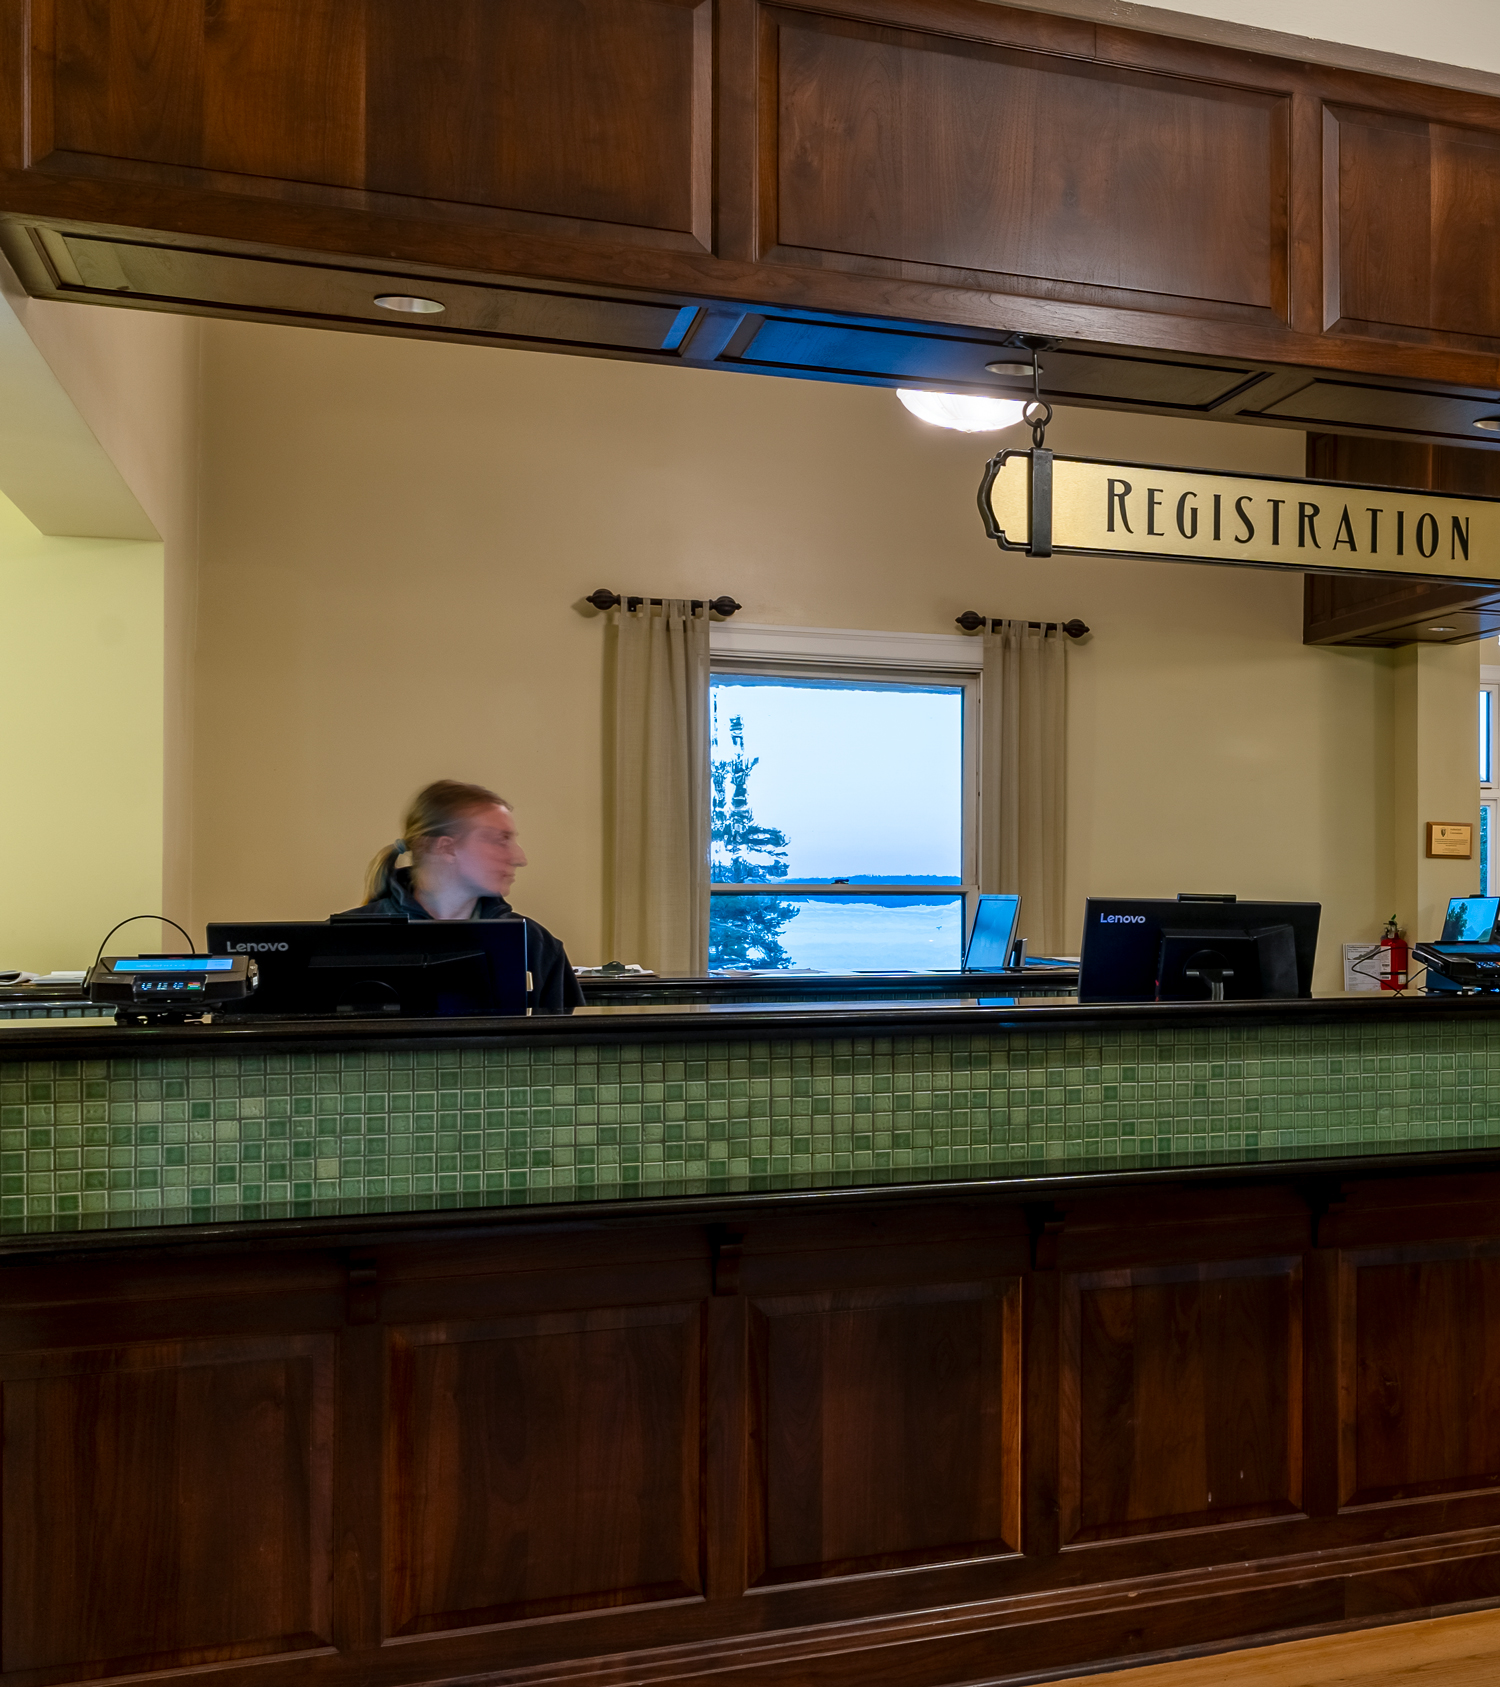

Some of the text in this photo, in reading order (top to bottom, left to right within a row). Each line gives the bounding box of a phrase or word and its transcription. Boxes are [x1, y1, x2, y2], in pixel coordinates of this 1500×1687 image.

[1106, 477, 1471, 562] REGISTRATION
[1100, 912, 1146, 923] Lenovo
[226, 941, 289, 952] Lenovo
